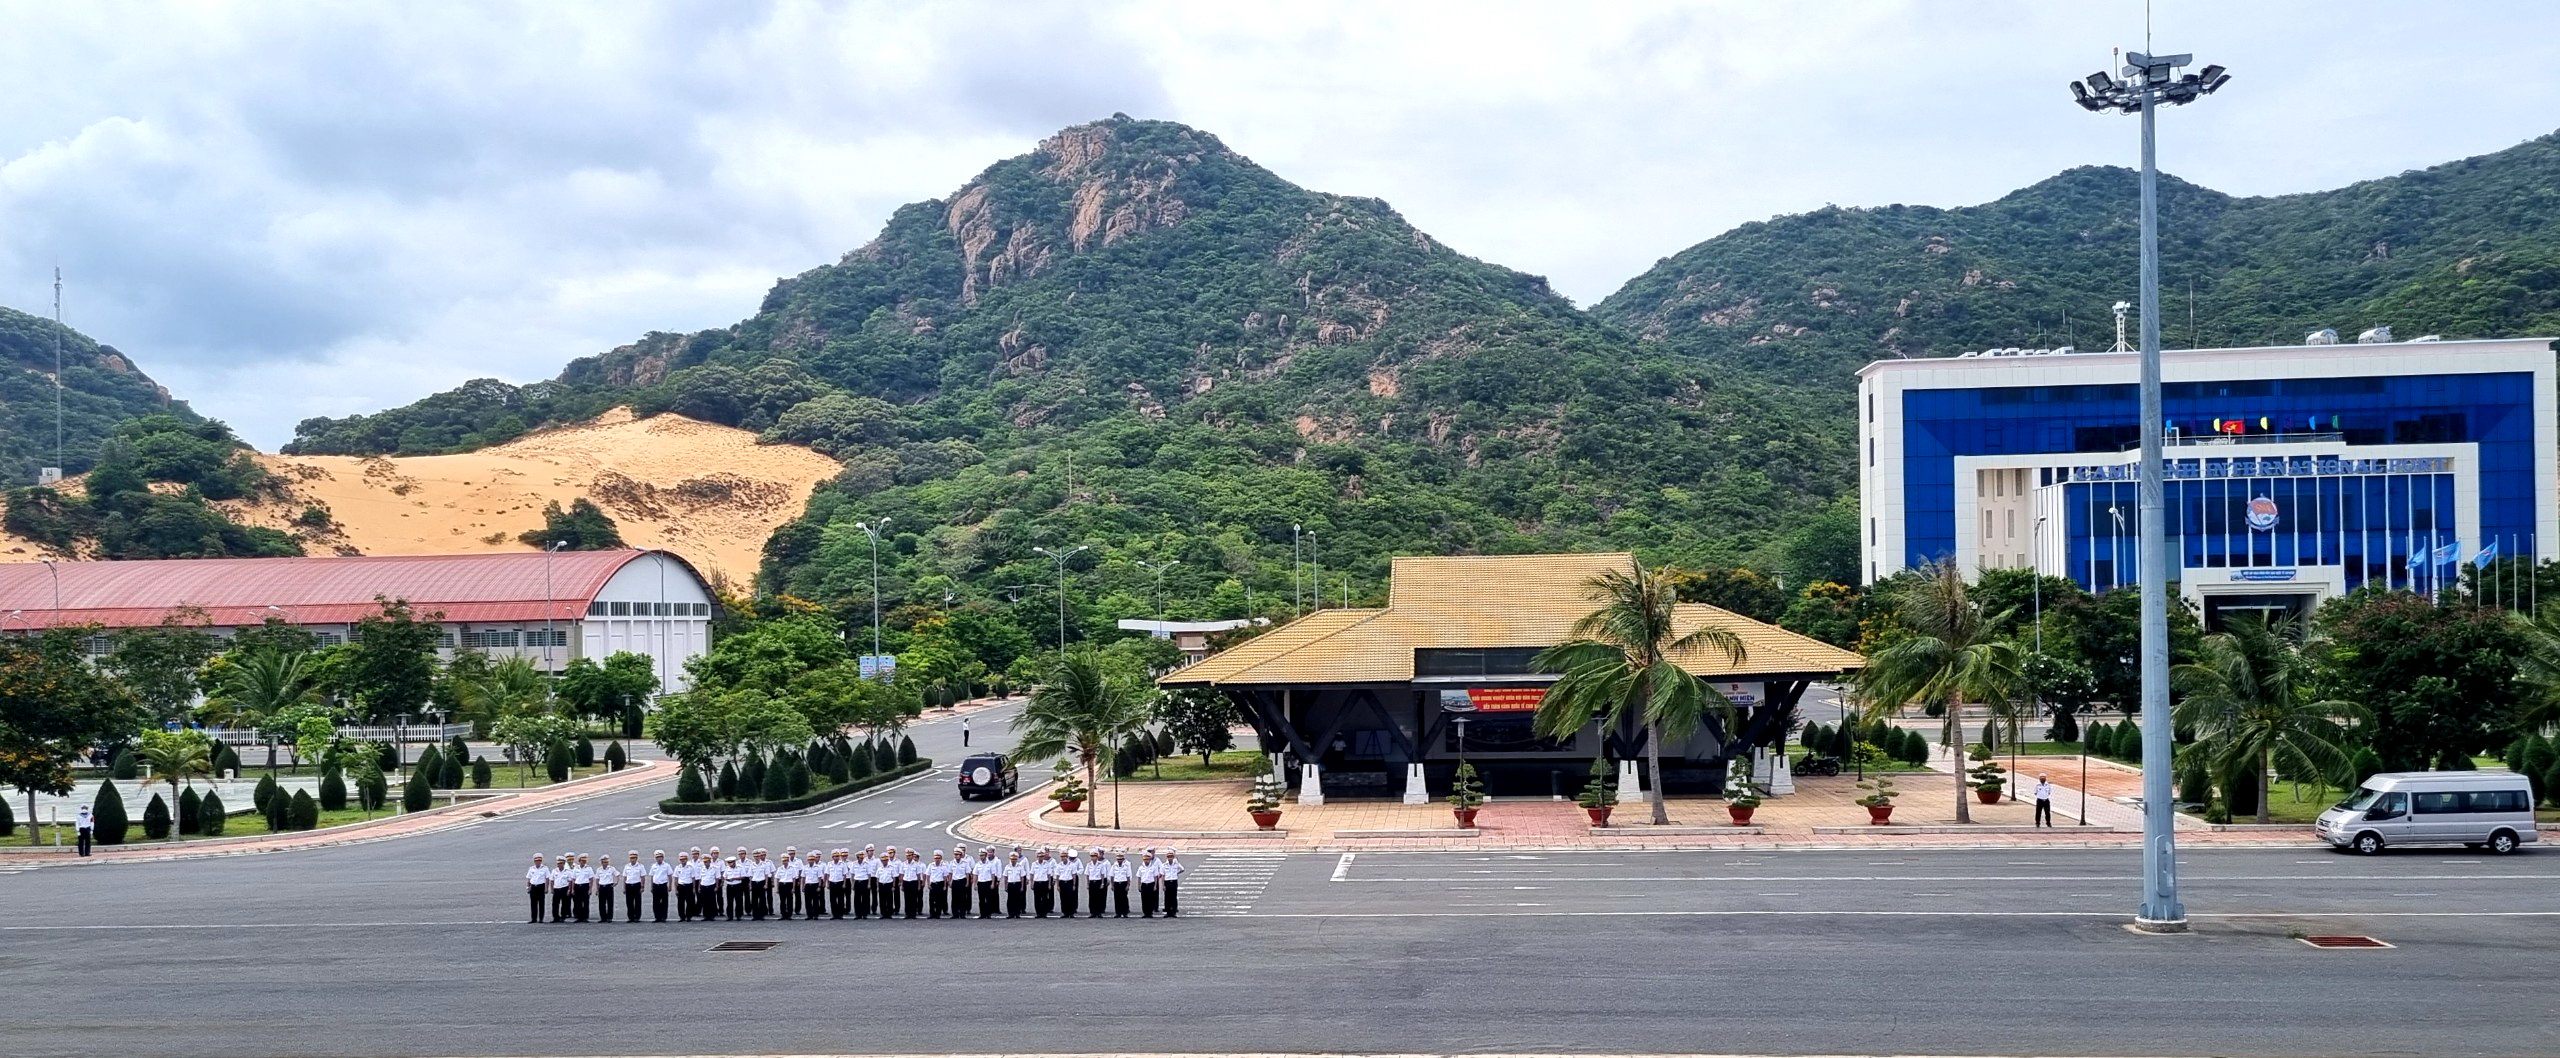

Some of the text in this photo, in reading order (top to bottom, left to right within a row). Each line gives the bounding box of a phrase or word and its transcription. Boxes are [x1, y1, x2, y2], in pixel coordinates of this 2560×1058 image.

[2075, 457, 2447, 481] CAM NH INTERNATIONAL PORT
